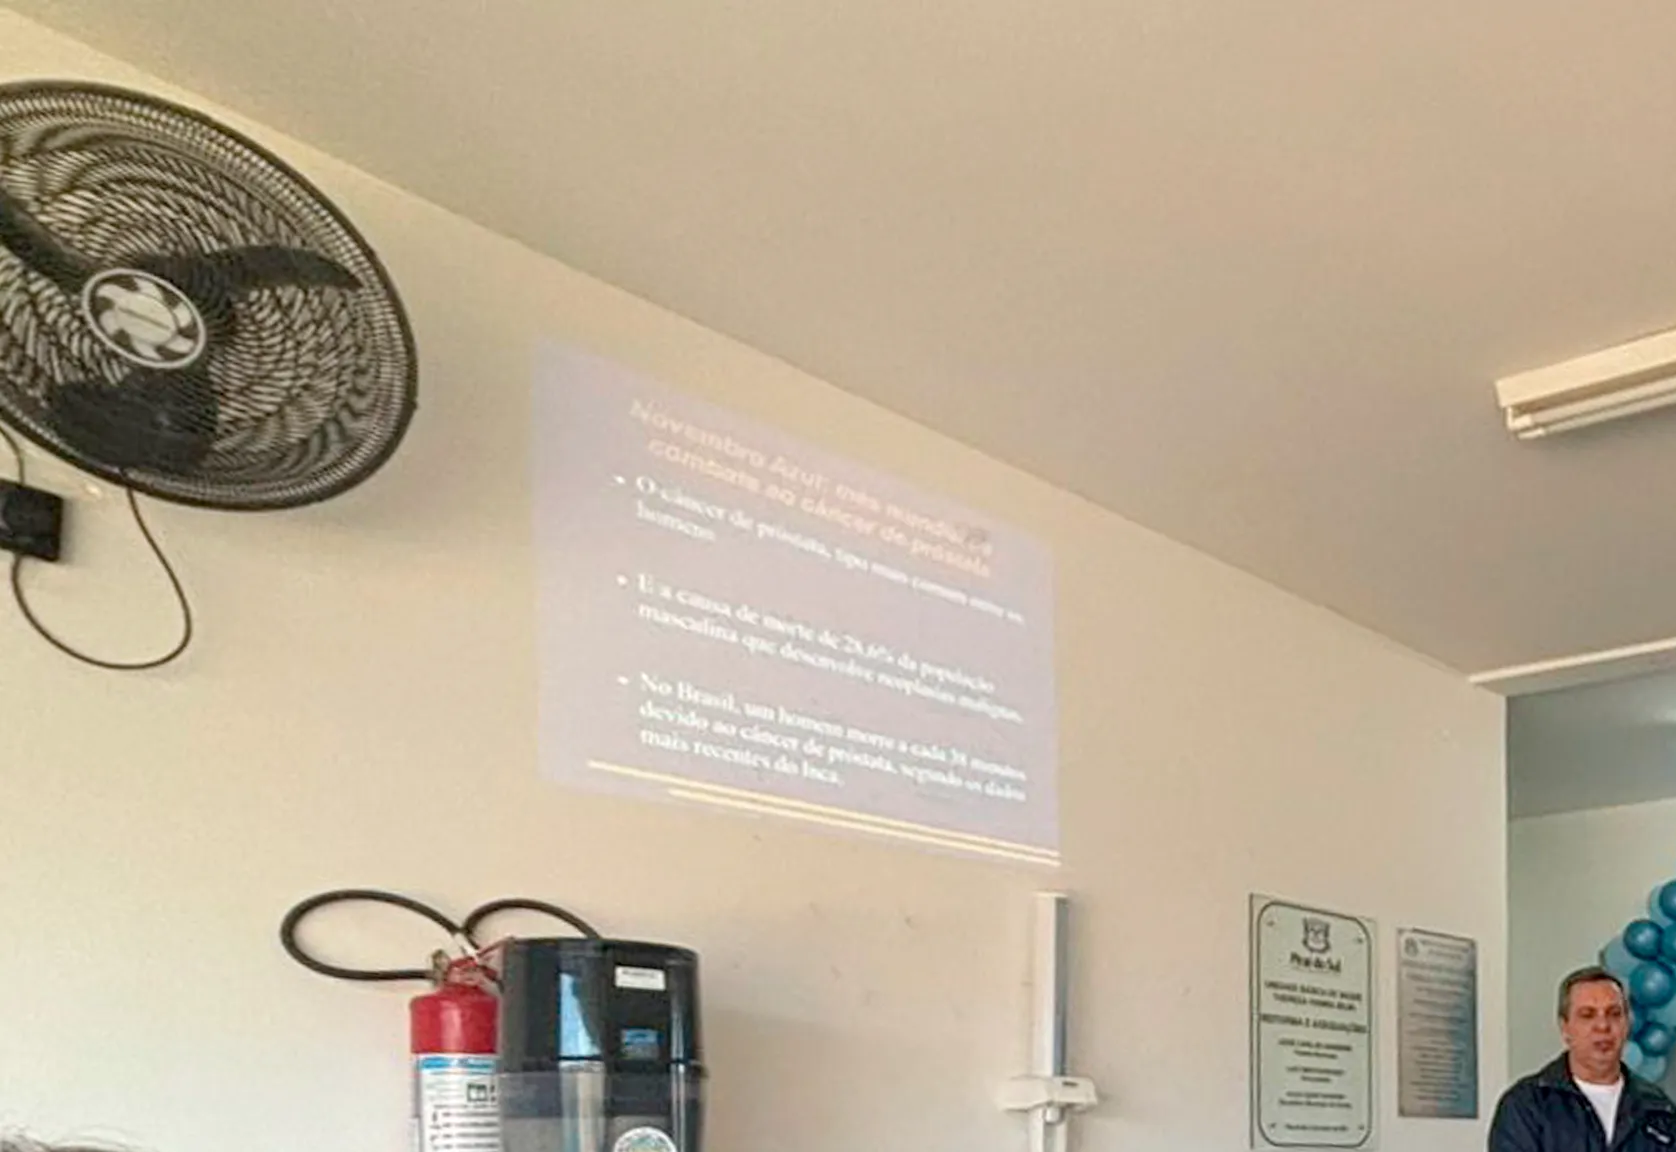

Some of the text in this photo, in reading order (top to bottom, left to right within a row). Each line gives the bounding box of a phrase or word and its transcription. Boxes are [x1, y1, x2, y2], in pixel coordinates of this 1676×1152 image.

[629, 399, 766, 468] Novembro
[636, 476, 656, 495] O
[659, 487, 725, 520] câncer
[728, 510, 753, 531] de
[648, 438, 760, 493] combate
[765, 483, 796, 507] ao
[880, 524, 908, 546] de
[638, 603, 739, 644] masculina
[741, 634, 779, 655] que
[675, 589, 732, 618] causa
[735, 603, 760, 626] de
[817, 630, 839, 650] de
[639, 700, 709, 731] devido
[711, 719, 738, 737] ao
[739, 724, 799, 751] câncer
[802, 737, 825, 758] de
[640, 671, 673, 696] No
[744, 701, 775, 722] um
[778, 704, 844, 738] homem
[640, 728, 690, 752] mais
[692, 740, 772, 770] recentes
[773, 753, 800, 775] do
